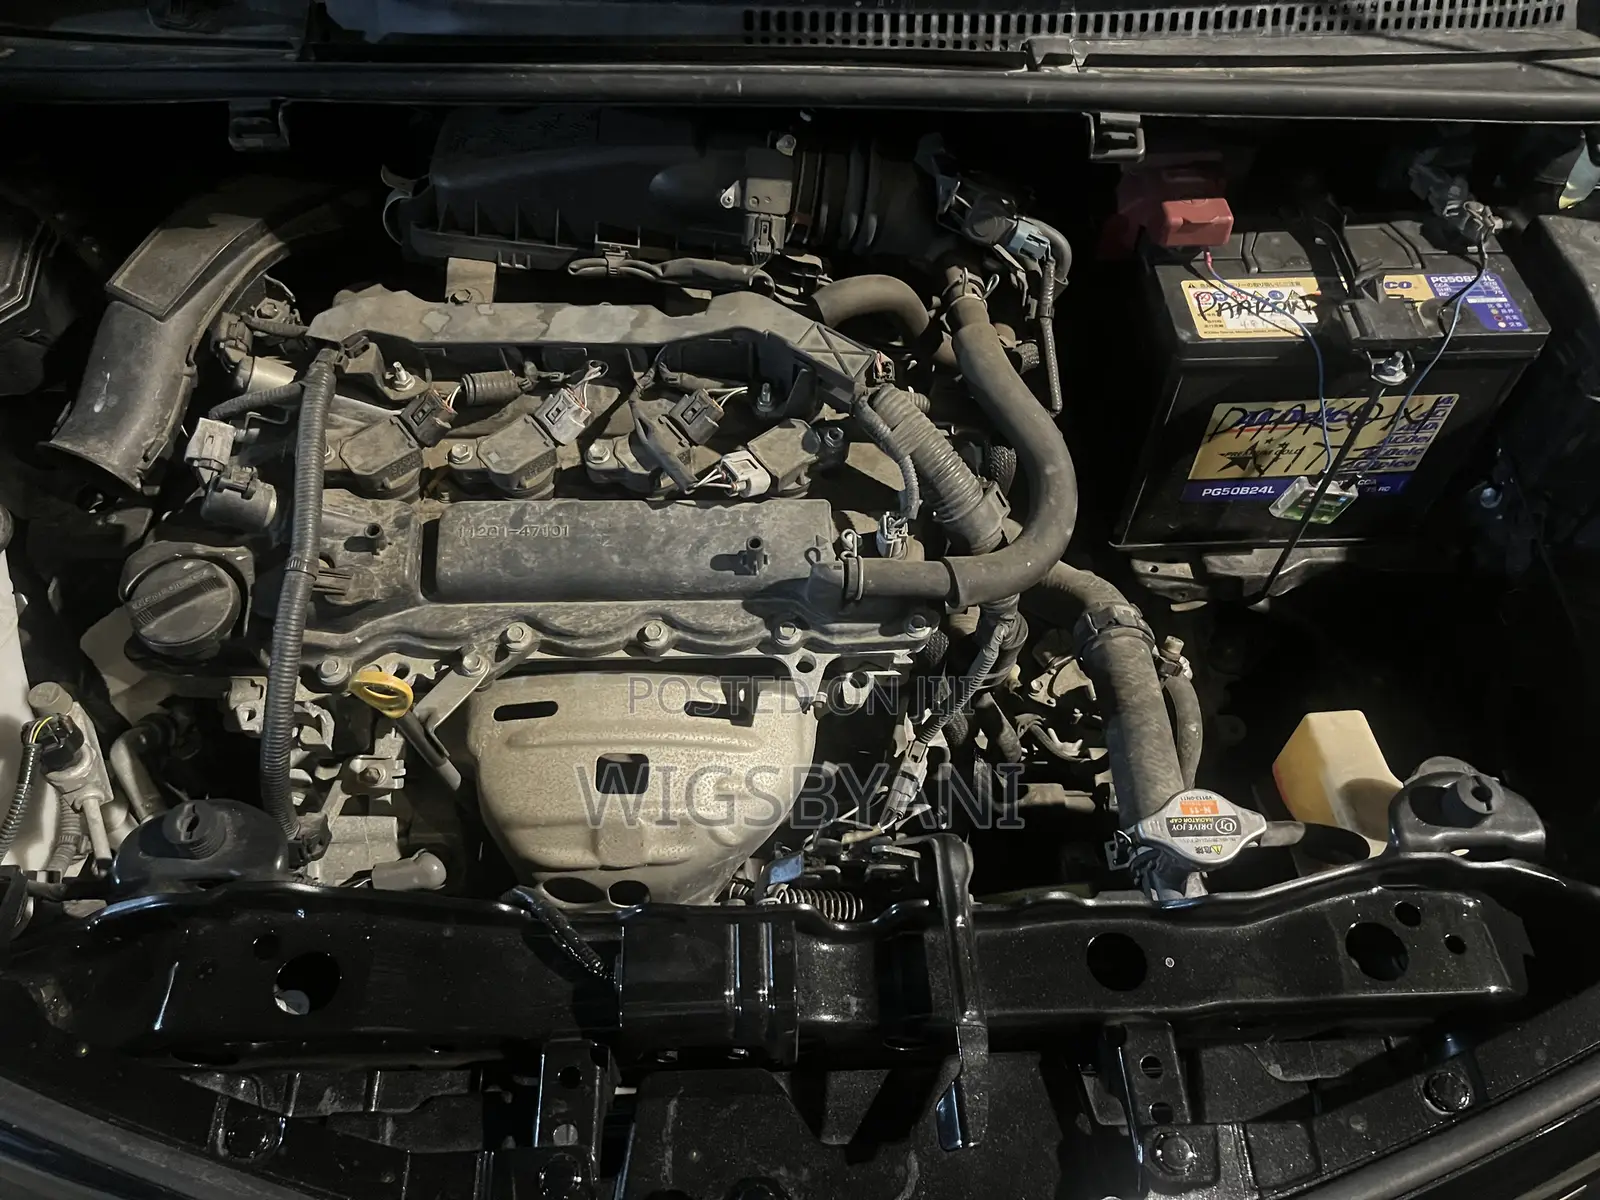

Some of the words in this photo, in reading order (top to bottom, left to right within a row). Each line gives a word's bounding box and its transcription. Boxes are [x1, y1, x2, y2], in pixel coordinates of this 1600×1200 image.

[1202, 485, 1275, 497] PG50B24L
[1171, 823, 1187, 831] JOY
[1188, 823, 1213, 831] DRIVE
